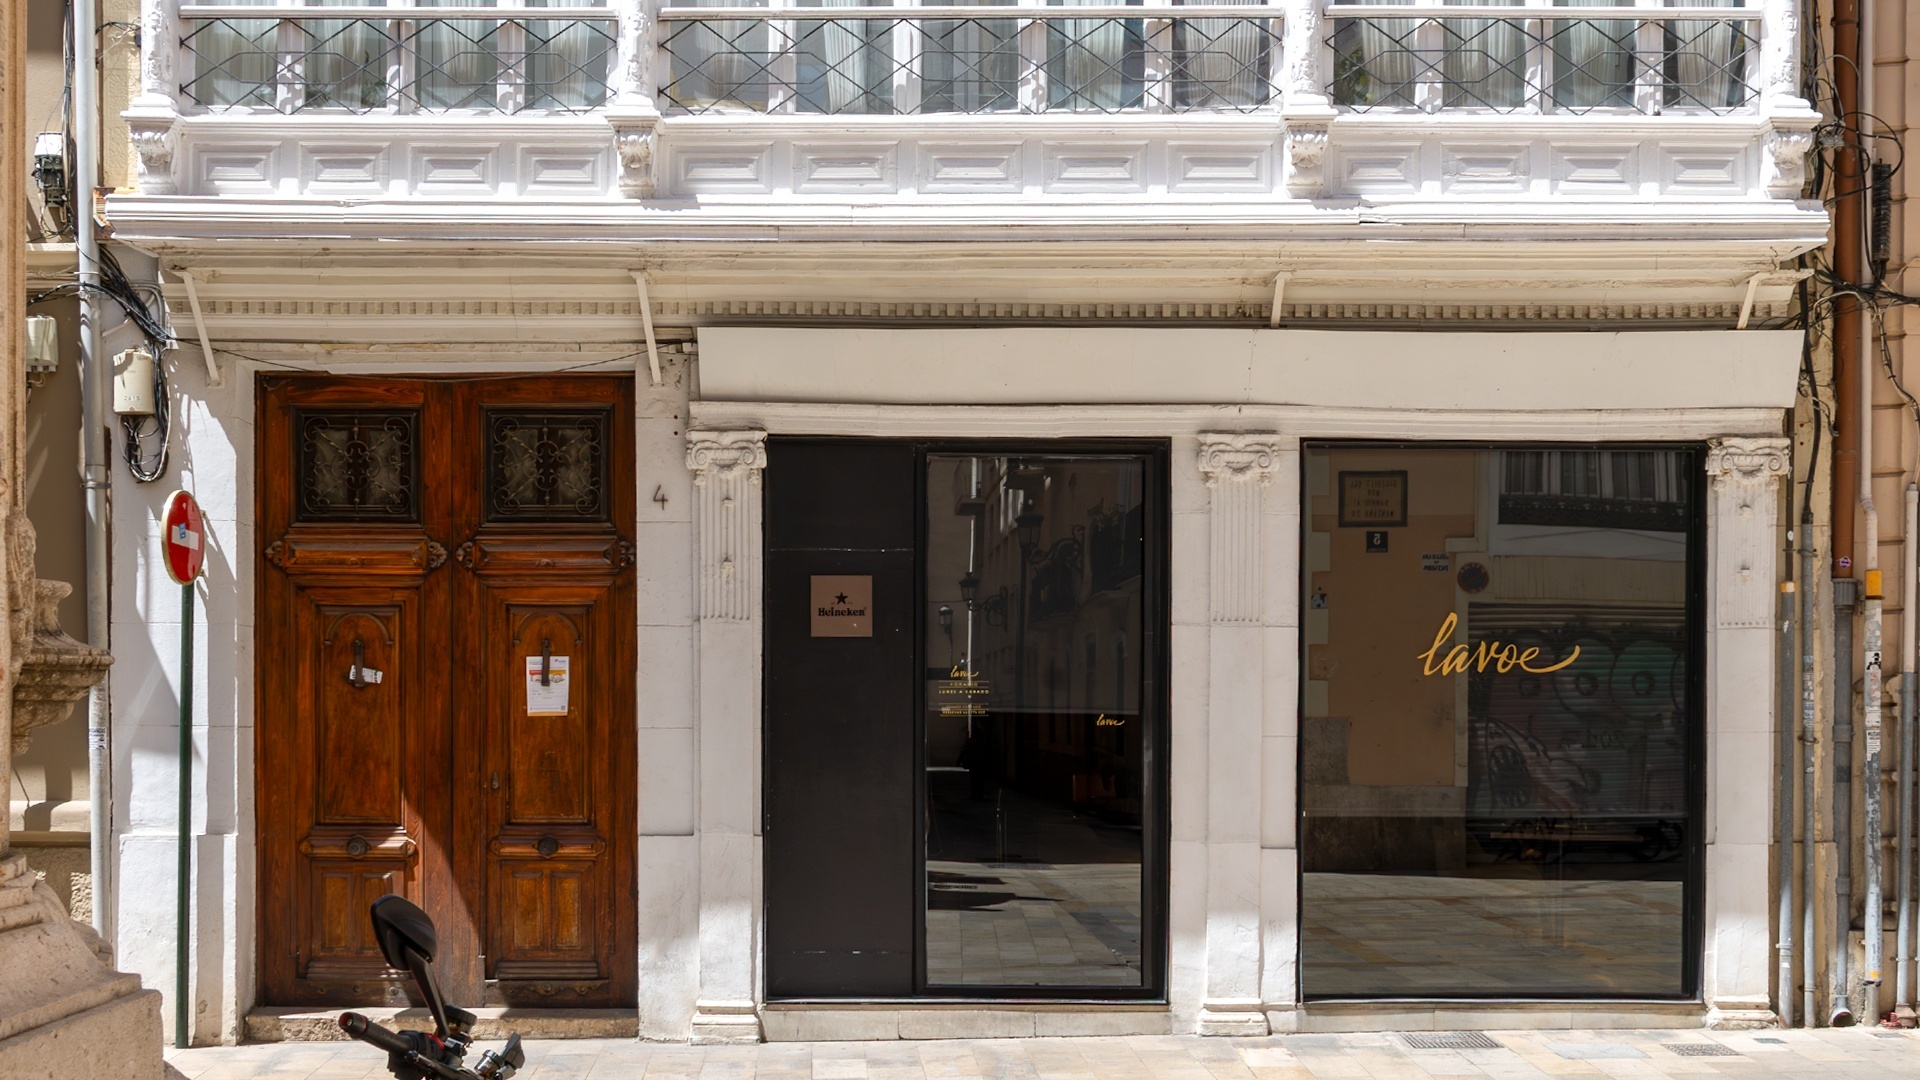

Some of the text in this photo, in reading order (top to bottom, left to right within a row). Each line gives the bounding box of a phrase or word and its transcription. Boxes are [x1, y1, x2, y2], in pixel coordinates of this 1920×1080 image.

[653, 484, 669, 511] 4
[817, 607, 865, 617] Heineken
[1416, 611, 1581, 677] lavoe
